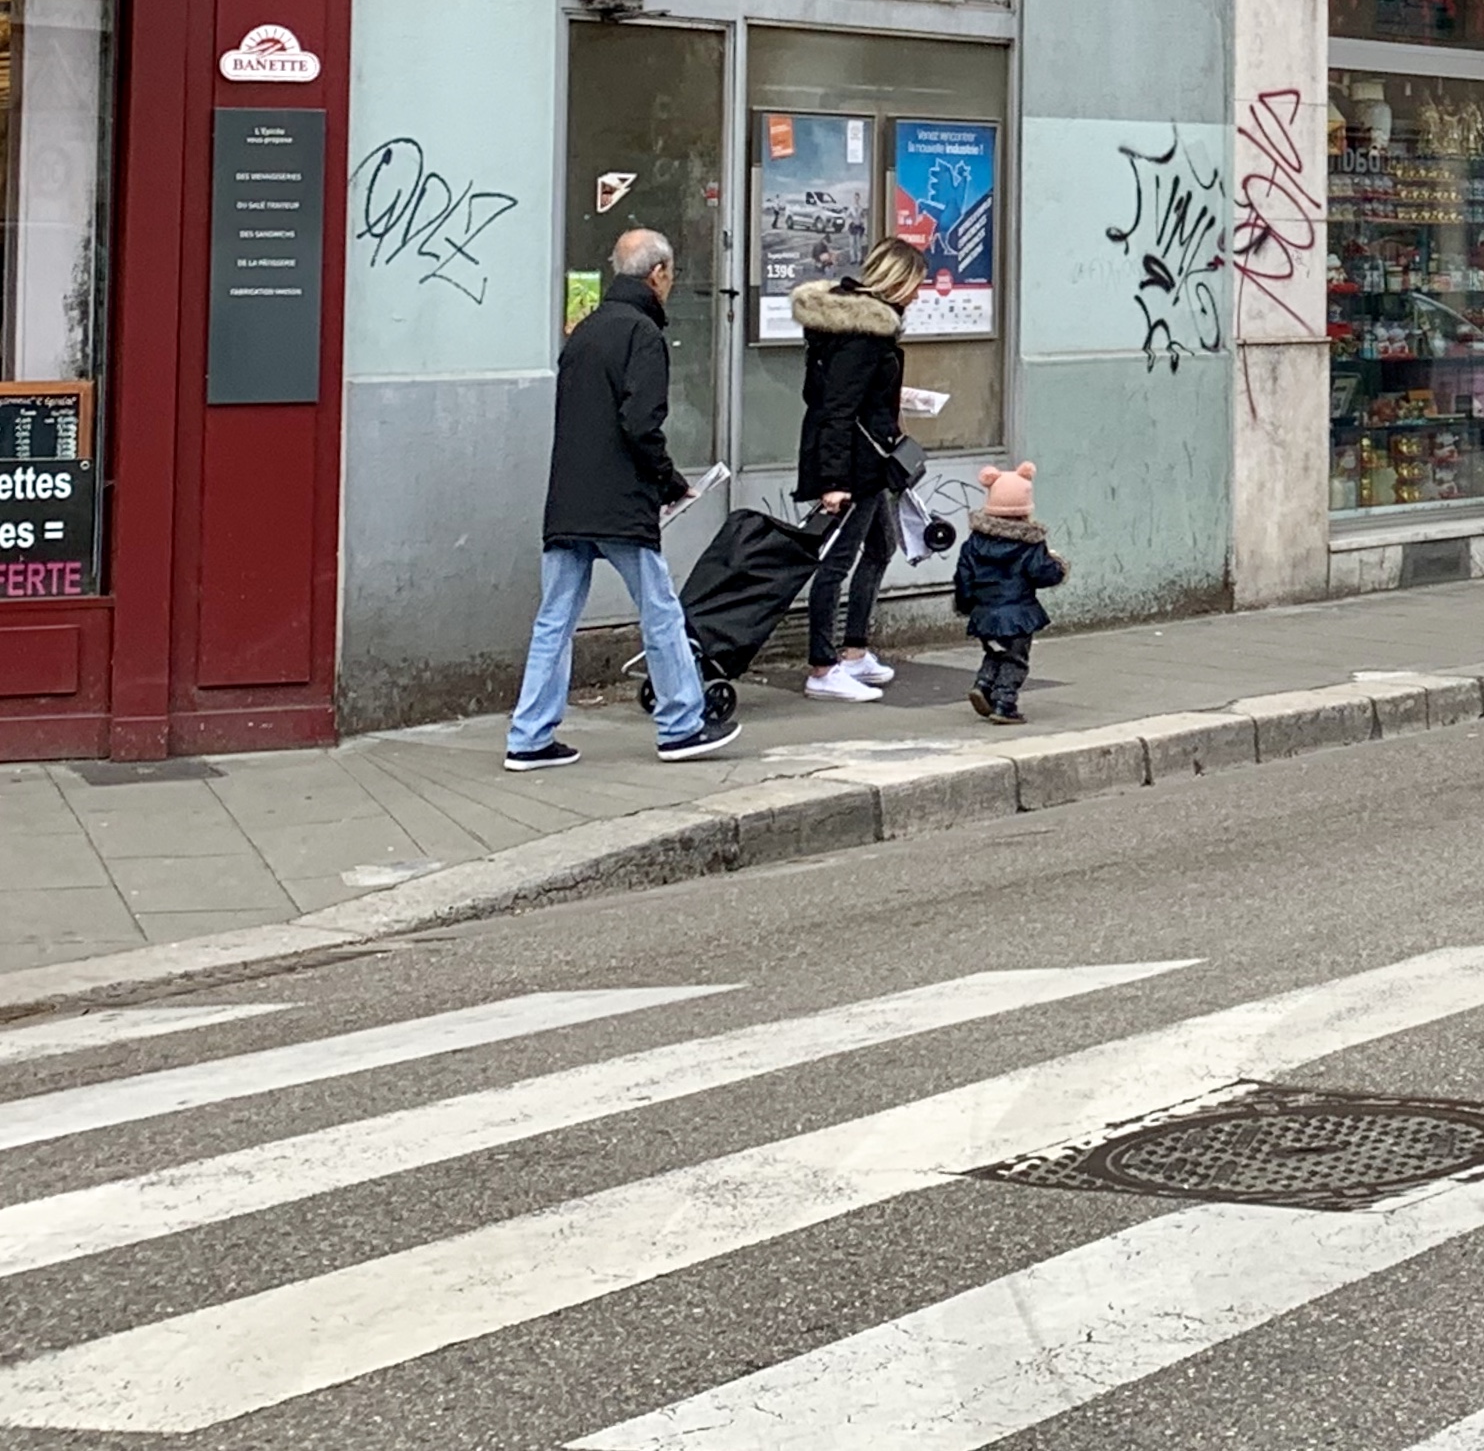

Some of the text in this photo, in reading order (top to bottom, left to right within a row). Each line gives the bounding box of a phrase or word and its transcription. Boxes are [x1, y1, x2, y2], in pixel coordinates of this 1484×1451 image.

[233, 58, 308, 72] BANETTE
[945, 143, 979, 155] industrie
[766, 264, 796, 279] 139€
[0, 466, 72, 500] ettes
